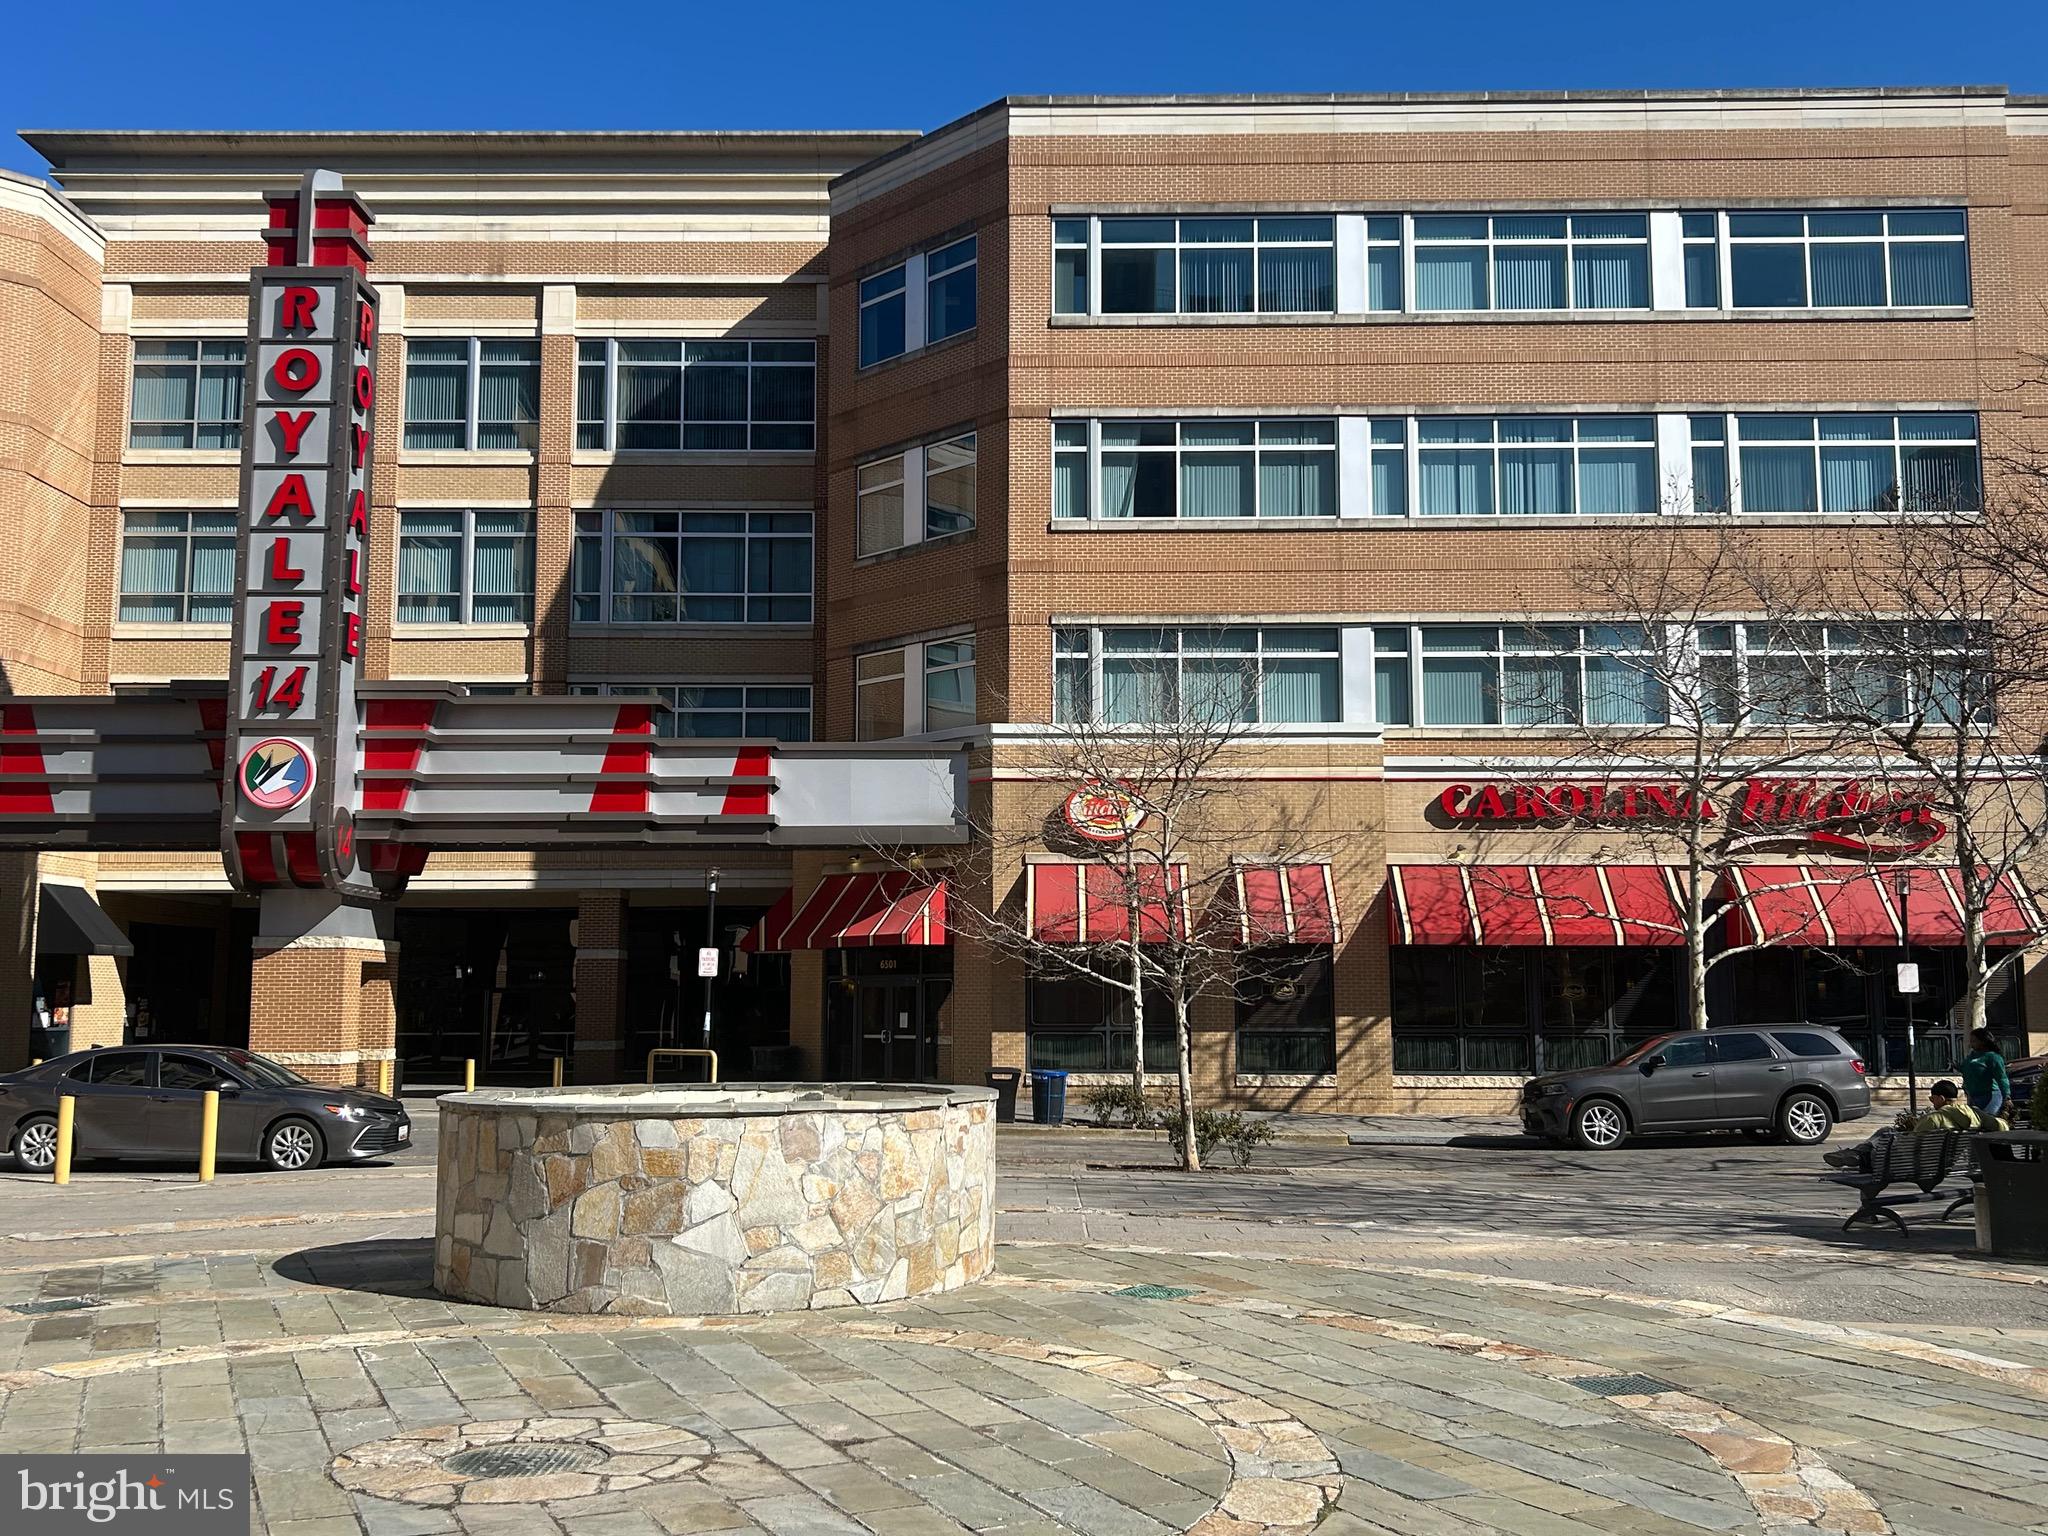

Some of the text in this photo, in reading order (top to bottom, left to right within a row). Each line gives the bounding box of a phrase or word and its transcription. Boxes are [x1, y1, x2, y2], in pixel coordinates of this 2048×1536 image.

[266, 285, 321, 643] ROYALE
[346, 302, 373, 658] ROYALE
[255, 665, 310, 709] 14
[1441, 784, 1719, 818] CAROLINA
[336, 824, 353, 859] 14
[880, 959, 897, 969] 6501
